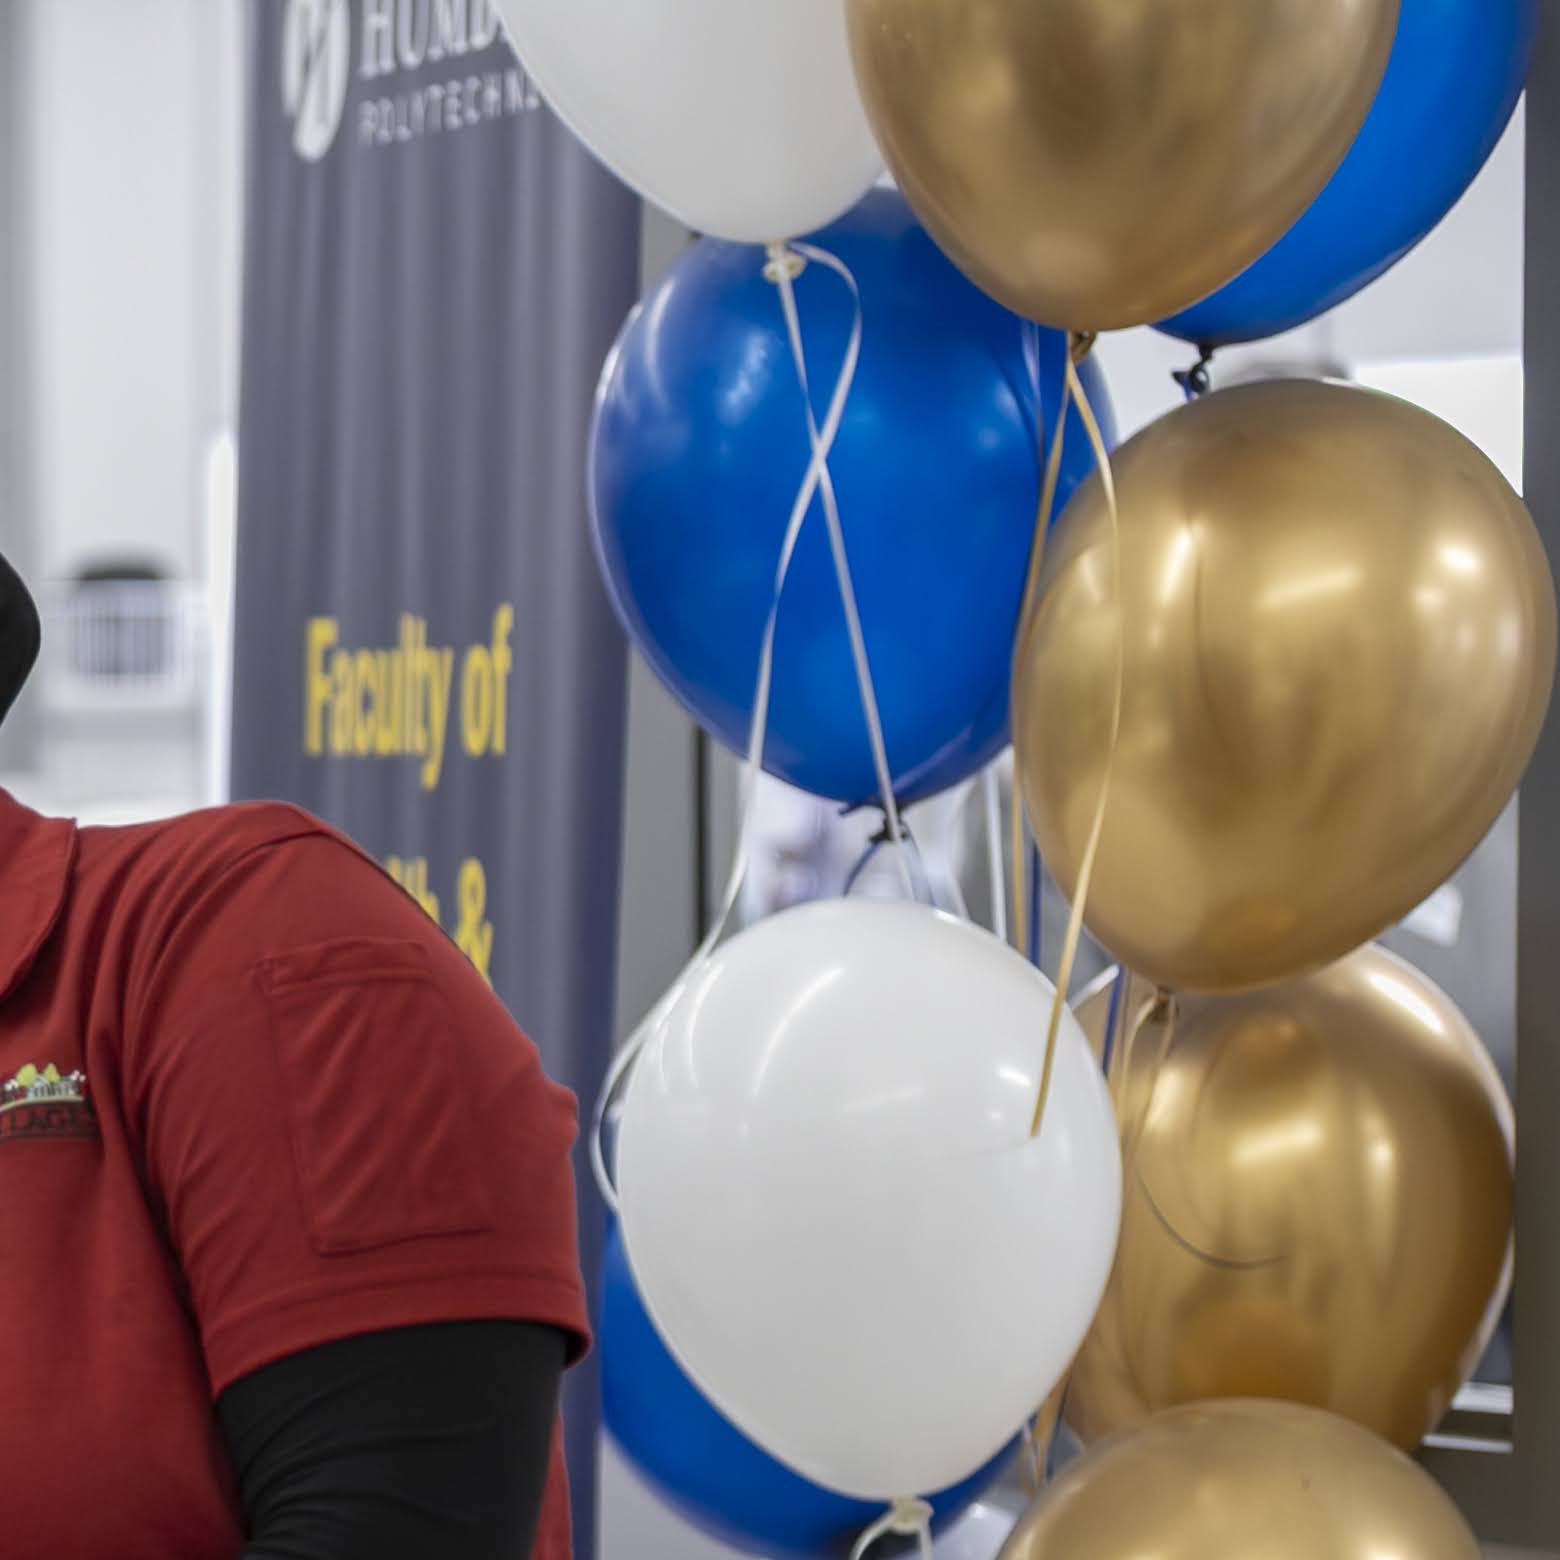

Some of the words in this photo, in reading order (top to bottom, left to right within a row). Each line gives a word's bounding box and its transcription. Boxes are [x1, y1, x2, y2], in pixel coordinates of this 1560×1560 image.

[304, 612, 454, 790] Faculty
[461, 603, 515, 757] of
[454, 858, 493, 985] &
